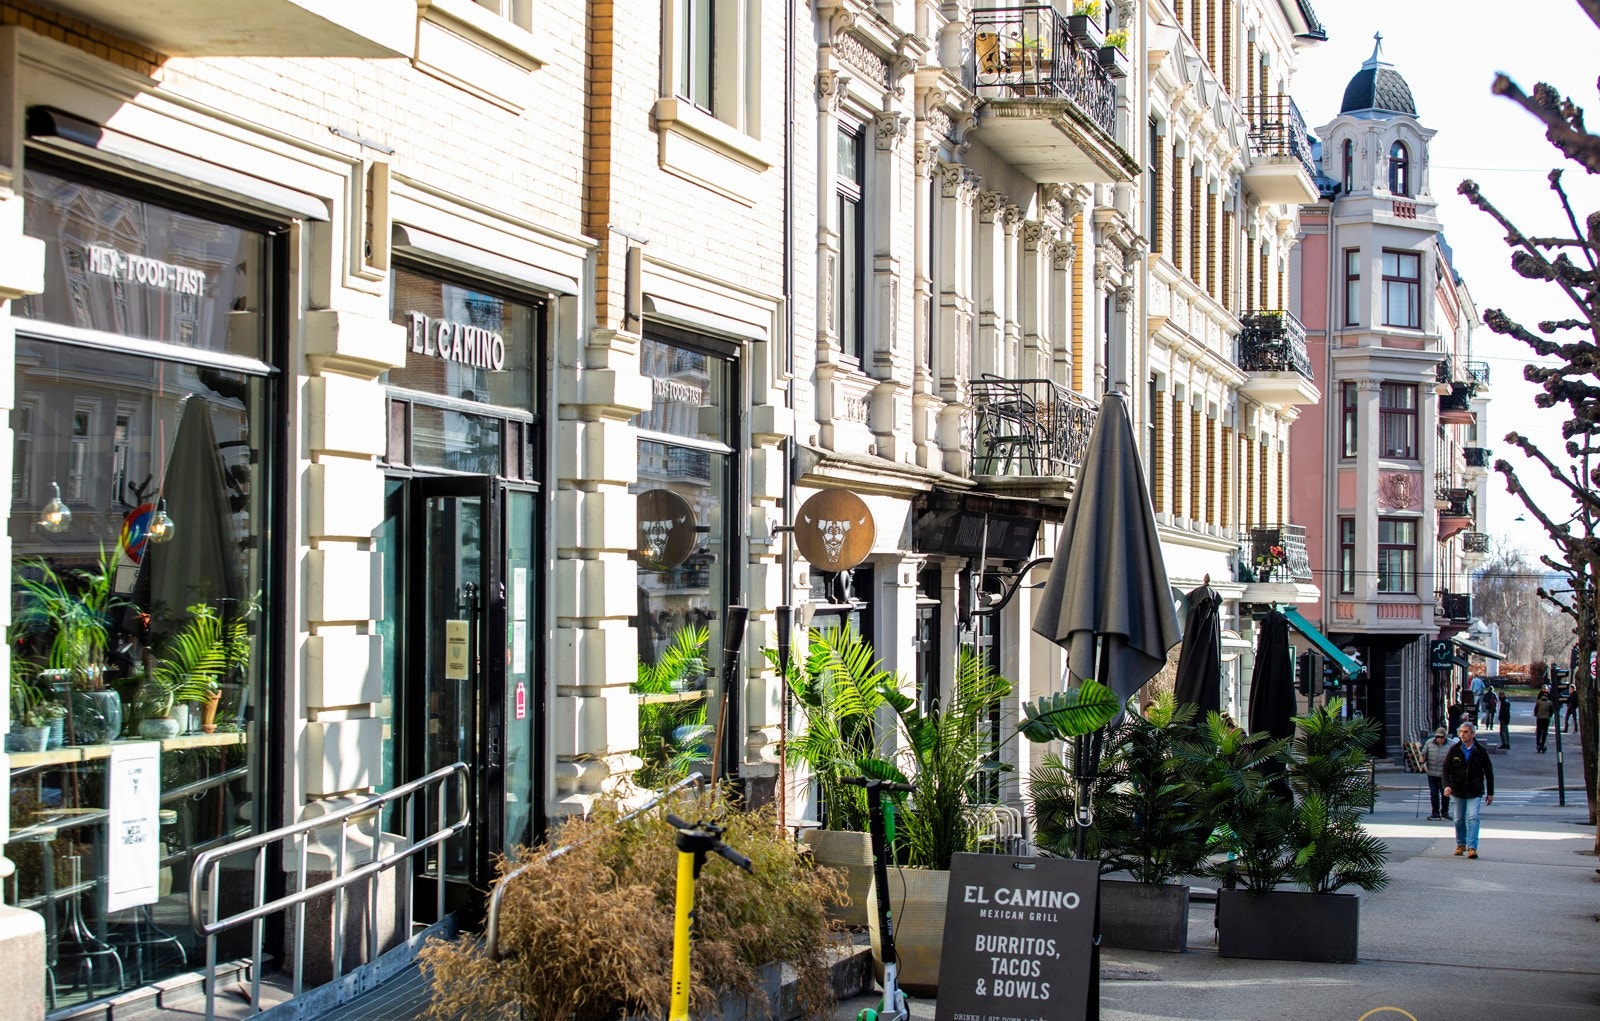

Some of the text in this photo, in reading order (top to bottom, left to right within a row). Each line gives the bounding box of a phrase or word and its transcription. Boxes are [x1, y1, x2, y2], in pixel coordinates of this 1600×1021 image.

[409, 311, 505, 371] EL CAMINO
[964, 886, 1081, 909] EL CAMINO
[980, 909, 1058, 922] MEXICAN GRILL
[975, 934, 1061, 959] BURRITOS,
[991, 957, 1041, 977] TACOS
[975, 978, 1051, 1000] & BOWLS
